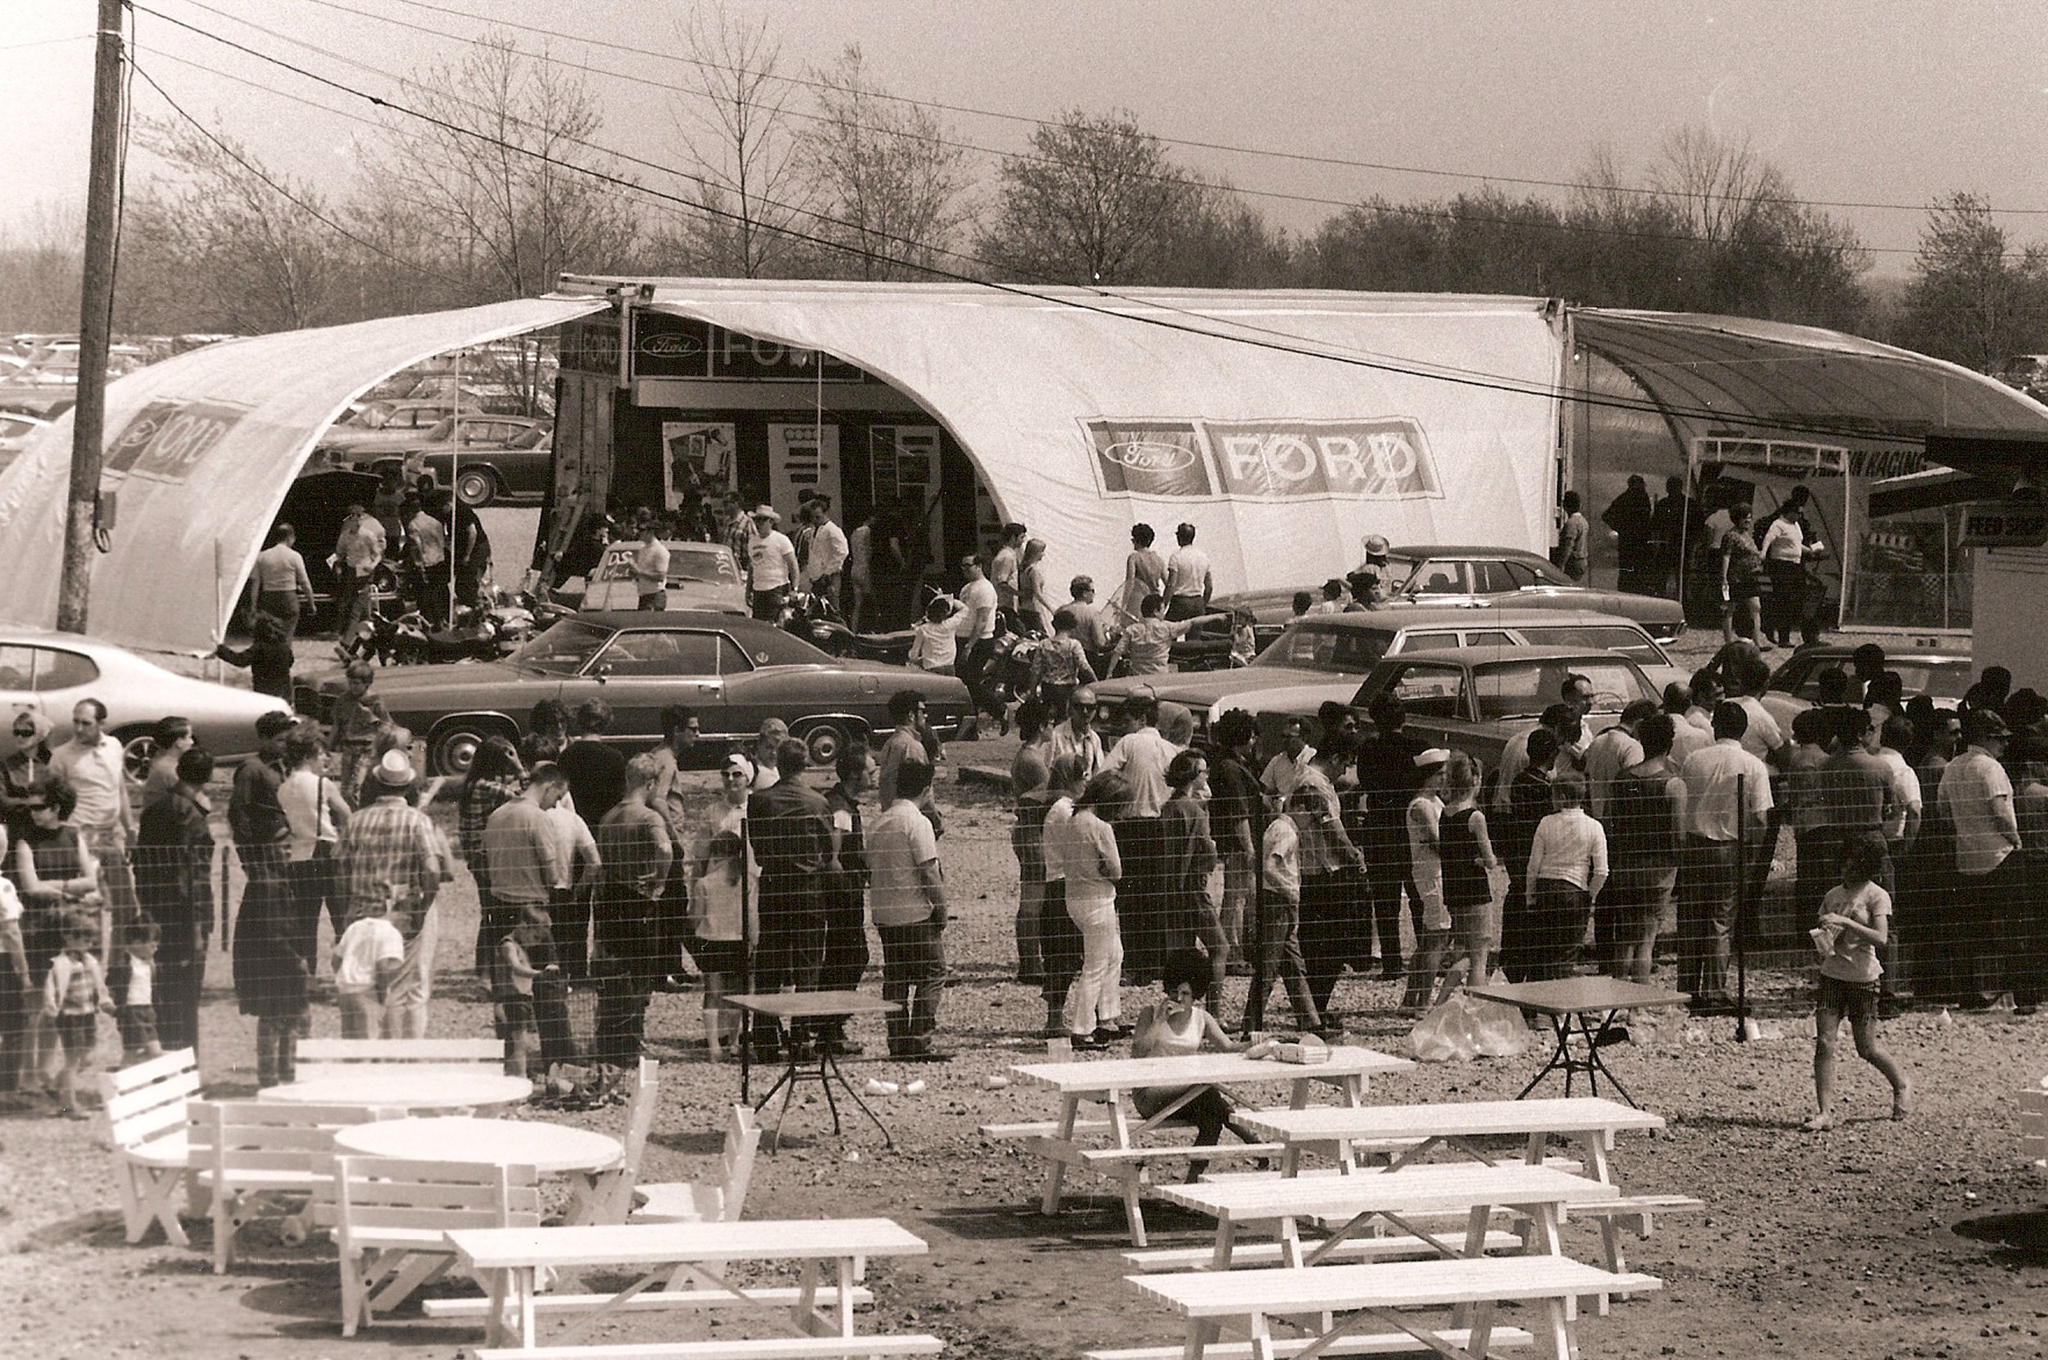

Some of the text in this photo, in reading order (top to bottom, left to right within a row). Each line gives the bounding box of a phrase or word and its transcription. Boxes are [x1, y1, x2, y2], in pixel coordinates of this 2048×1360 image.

[583, 333, 618, 365] FORD
[652, 329, 846, 367] Ford FO
[154, 414, 227, 463] ORD
[1123, 434, 1417, 482] Ford FORD
